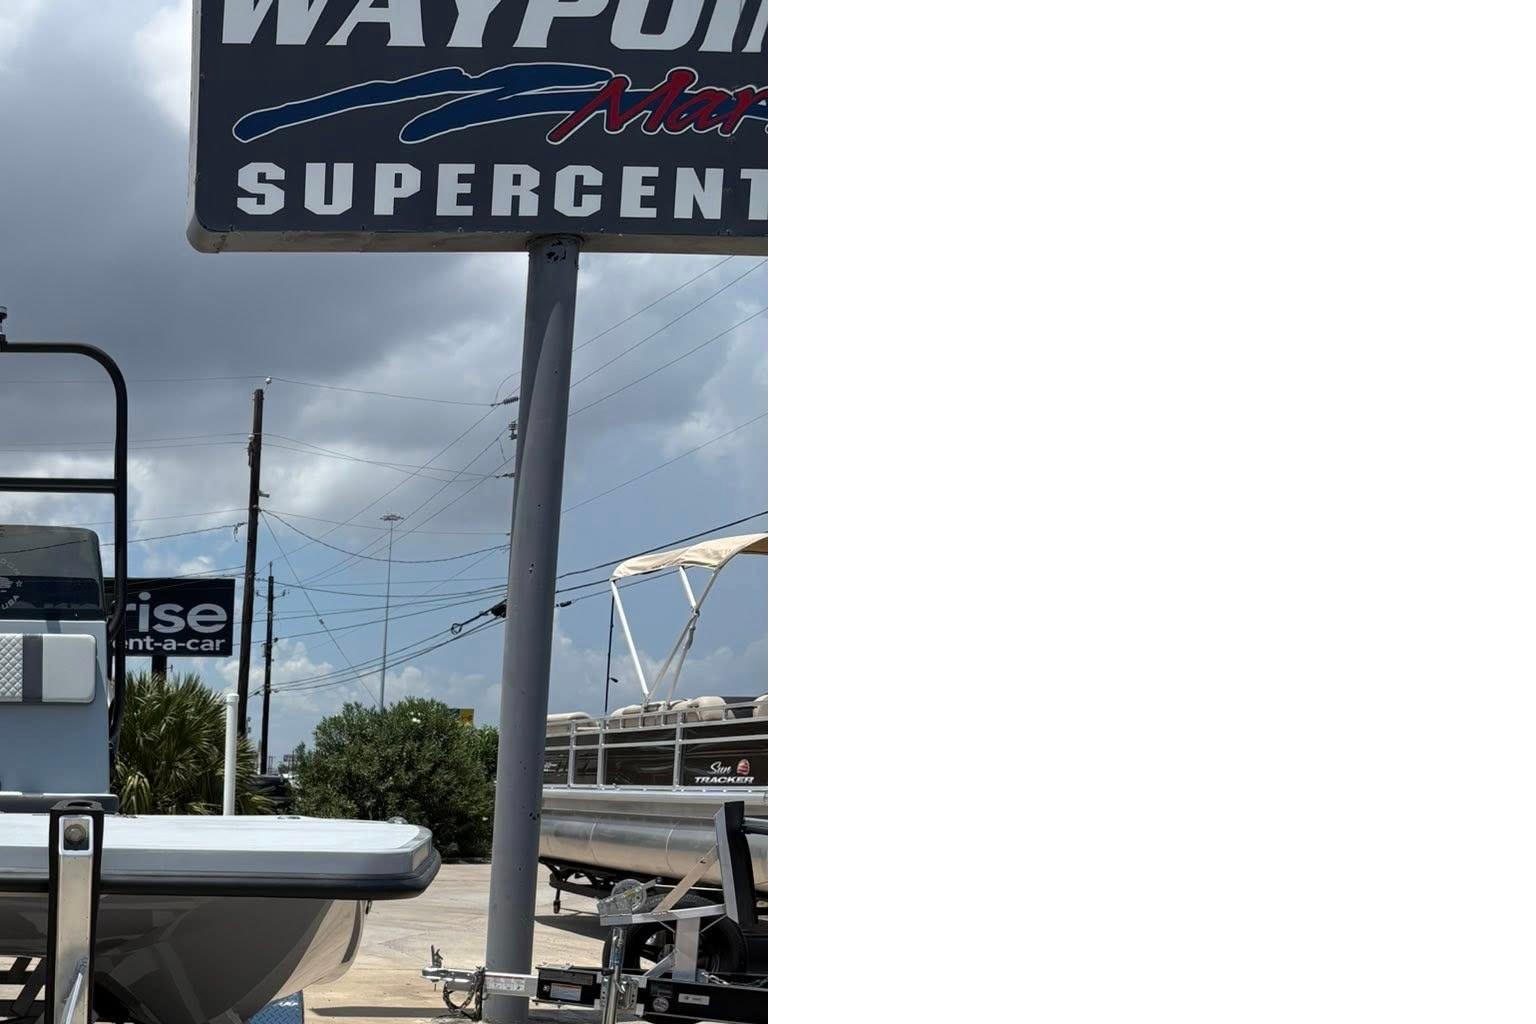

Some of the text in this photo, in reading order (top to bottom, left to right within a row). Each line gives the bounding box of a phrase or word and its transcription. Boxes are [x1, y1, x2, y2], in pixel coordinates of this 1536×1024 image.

[237, 162, 768, 220] SUPERCENT
[114, 636, 225, 651] nt-a-car
[707, 761, 731, 775] Sun
